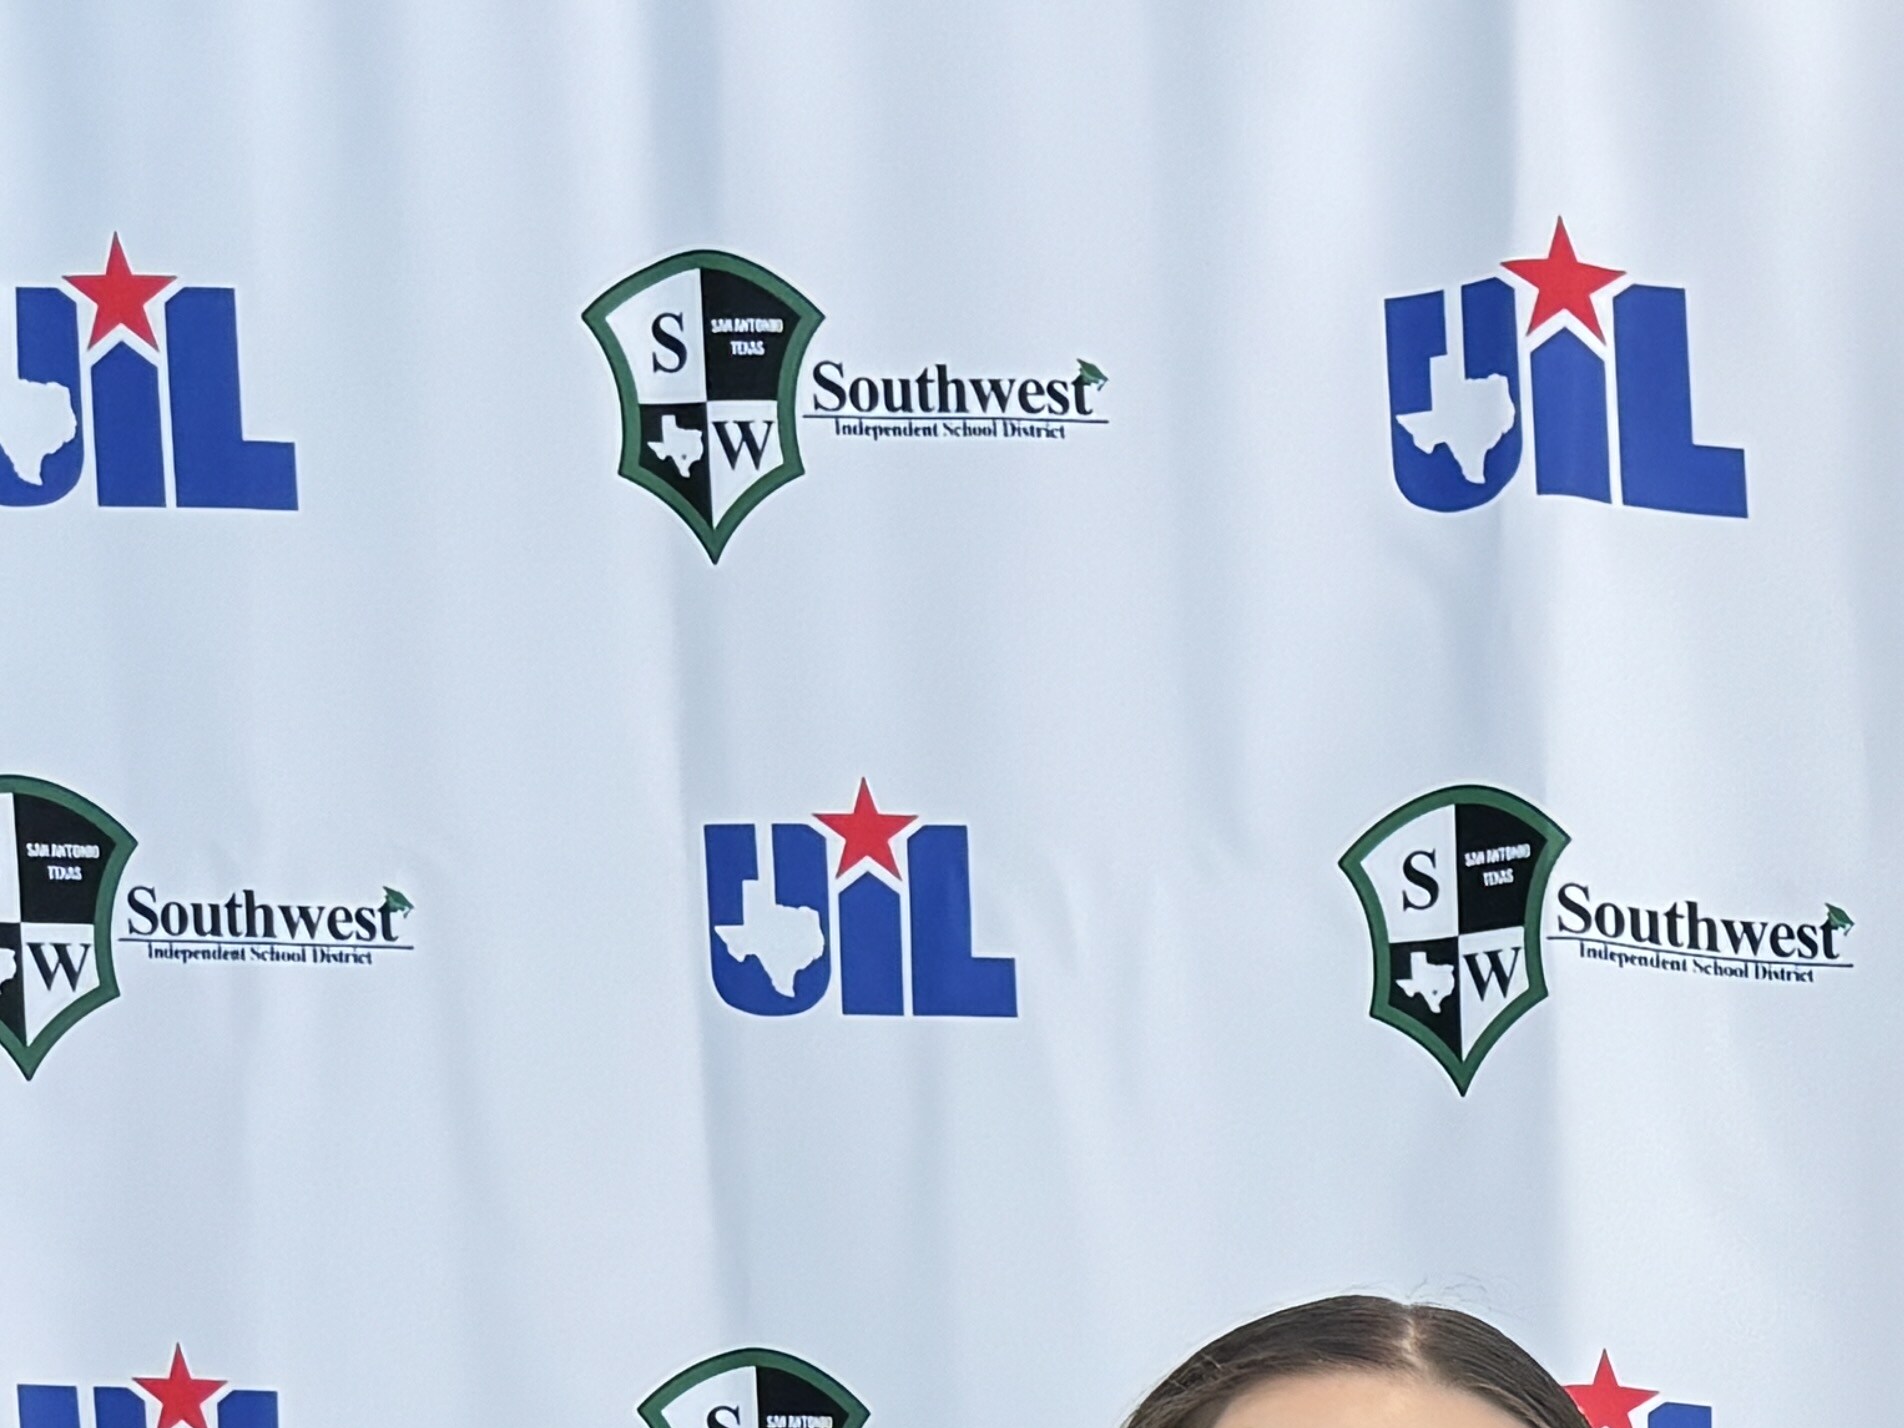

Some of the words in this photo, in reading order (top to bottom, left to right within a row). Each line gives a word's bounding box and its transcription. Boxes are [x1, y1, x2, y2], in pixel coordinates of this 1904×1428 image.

[650, 311, 688, 374] S
[811, 358, 1094, 417] Southwest
[712, 420, 773, 470] W
[1402, 842, 1439, 912] S
[126, 885, 400, 943] Southwest
[1556, 883, 1841, 962] Southwest
[26, 942, 90, 991] W
[1463, 946, 1521, 1001] W
